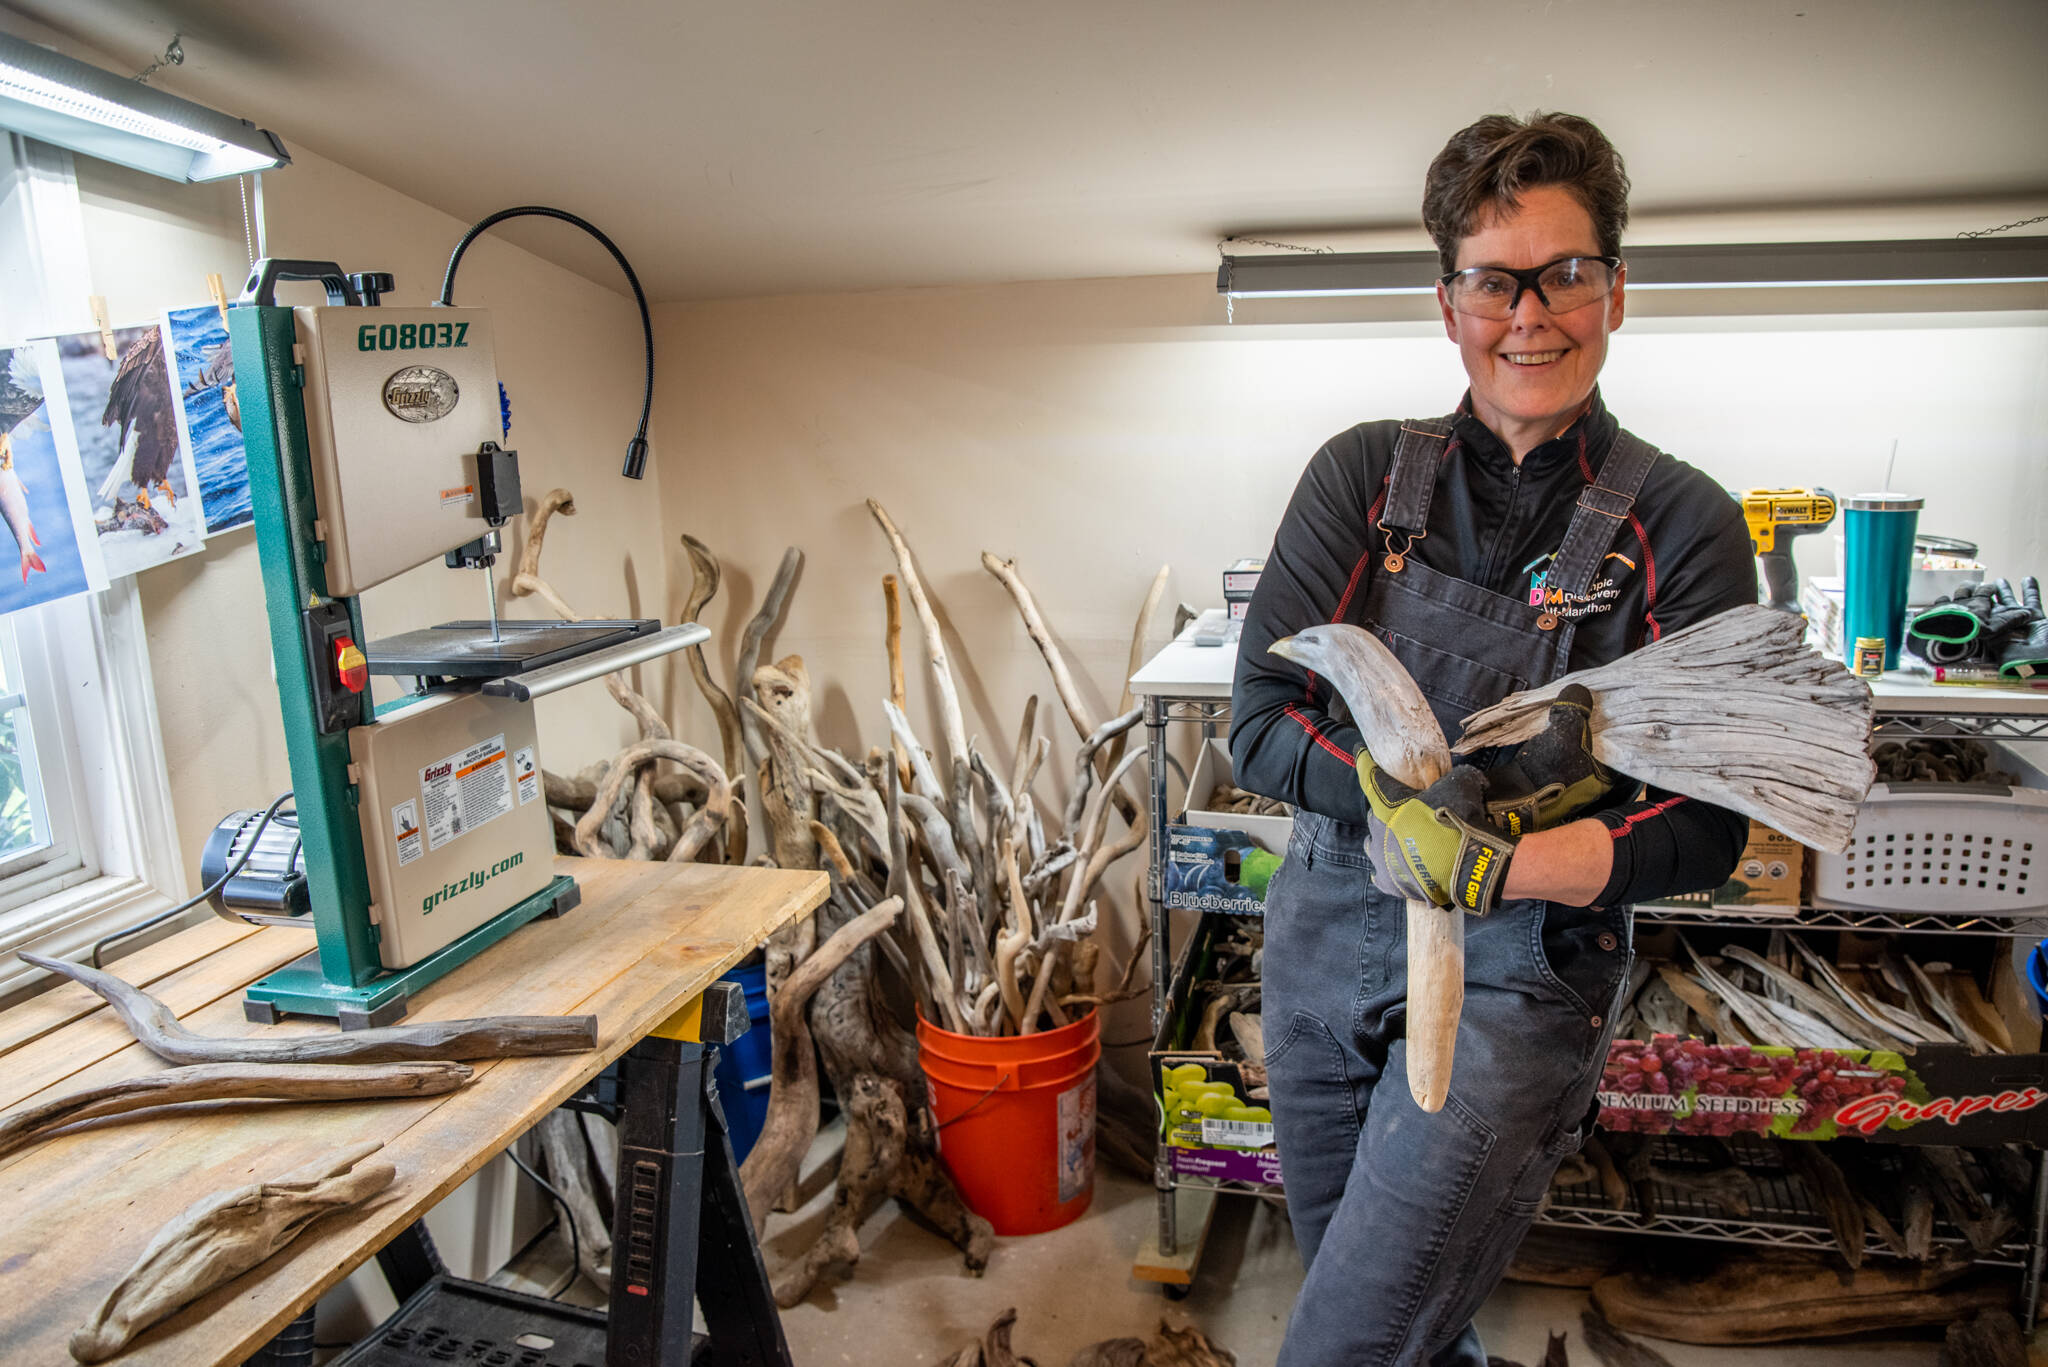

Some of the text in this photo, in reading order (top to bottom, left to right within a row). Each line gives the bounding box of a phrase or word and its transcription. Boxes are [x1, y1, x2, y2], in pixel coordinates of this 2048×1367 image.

[358, 322, 469, 352] G0803Z
[391, 387, 430, 405] Grizzly
[424, 763, 452, 782] Grizzly
[422, 851, 524, 916] grizzly.com
[1465, 847, 1493, 908] FIRM GRIP
[1697, 1095, 1808, 1115] SEEDLESS
[1834, 1087, 2047, 1134] Grapes
